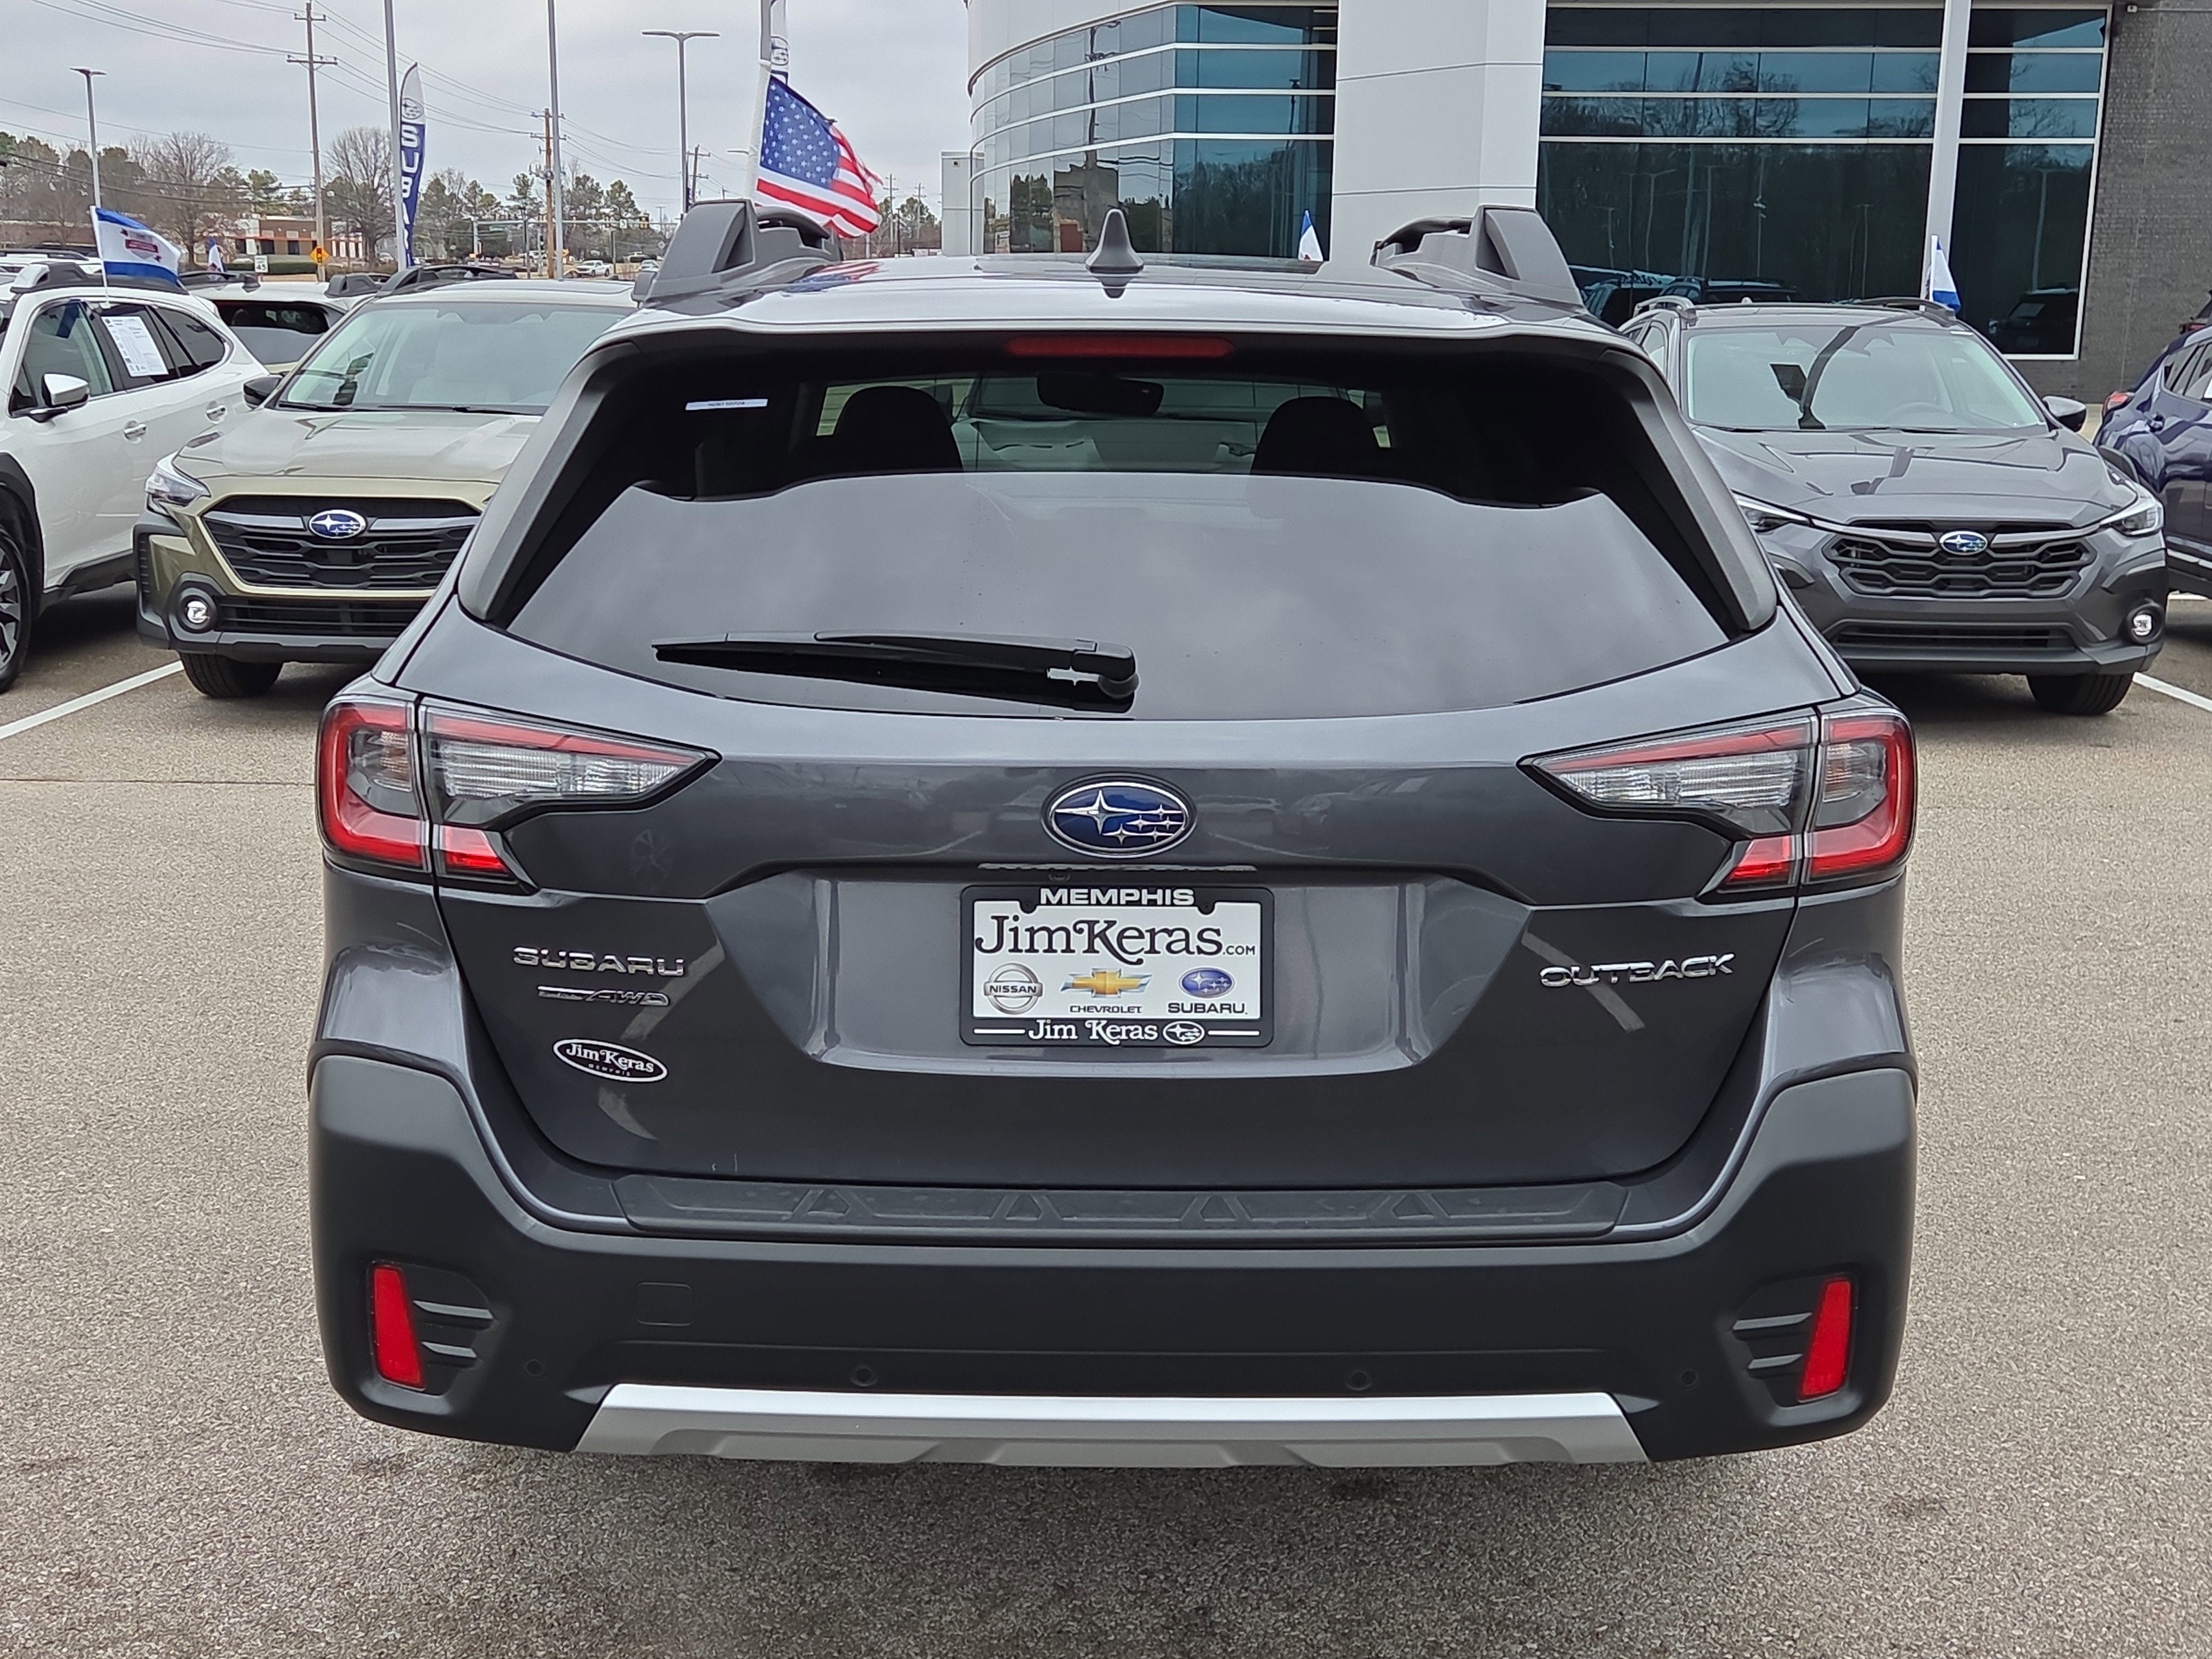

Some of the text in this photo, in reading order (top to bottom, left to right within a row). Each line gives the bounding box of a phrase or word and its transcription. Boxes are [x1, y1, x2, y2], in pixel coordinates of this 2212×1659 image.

[401, 124, 420, 266] SUB
[1040, 889, 1194, 905] MEMPHIS
[513, 946, 685, 976] SUBARU
[1539, 953, 1735, 988] OUTBACK
[586, 989, 670, 1006] AWD
[989, 985, 1037, 993] NISSAN
[1070, 1006, 1142, 1014] CHEVROLET
[1168, 1003, 1246, 1013] SUBARU
[1028, 1019, 1159, 1045] Jim Keras
